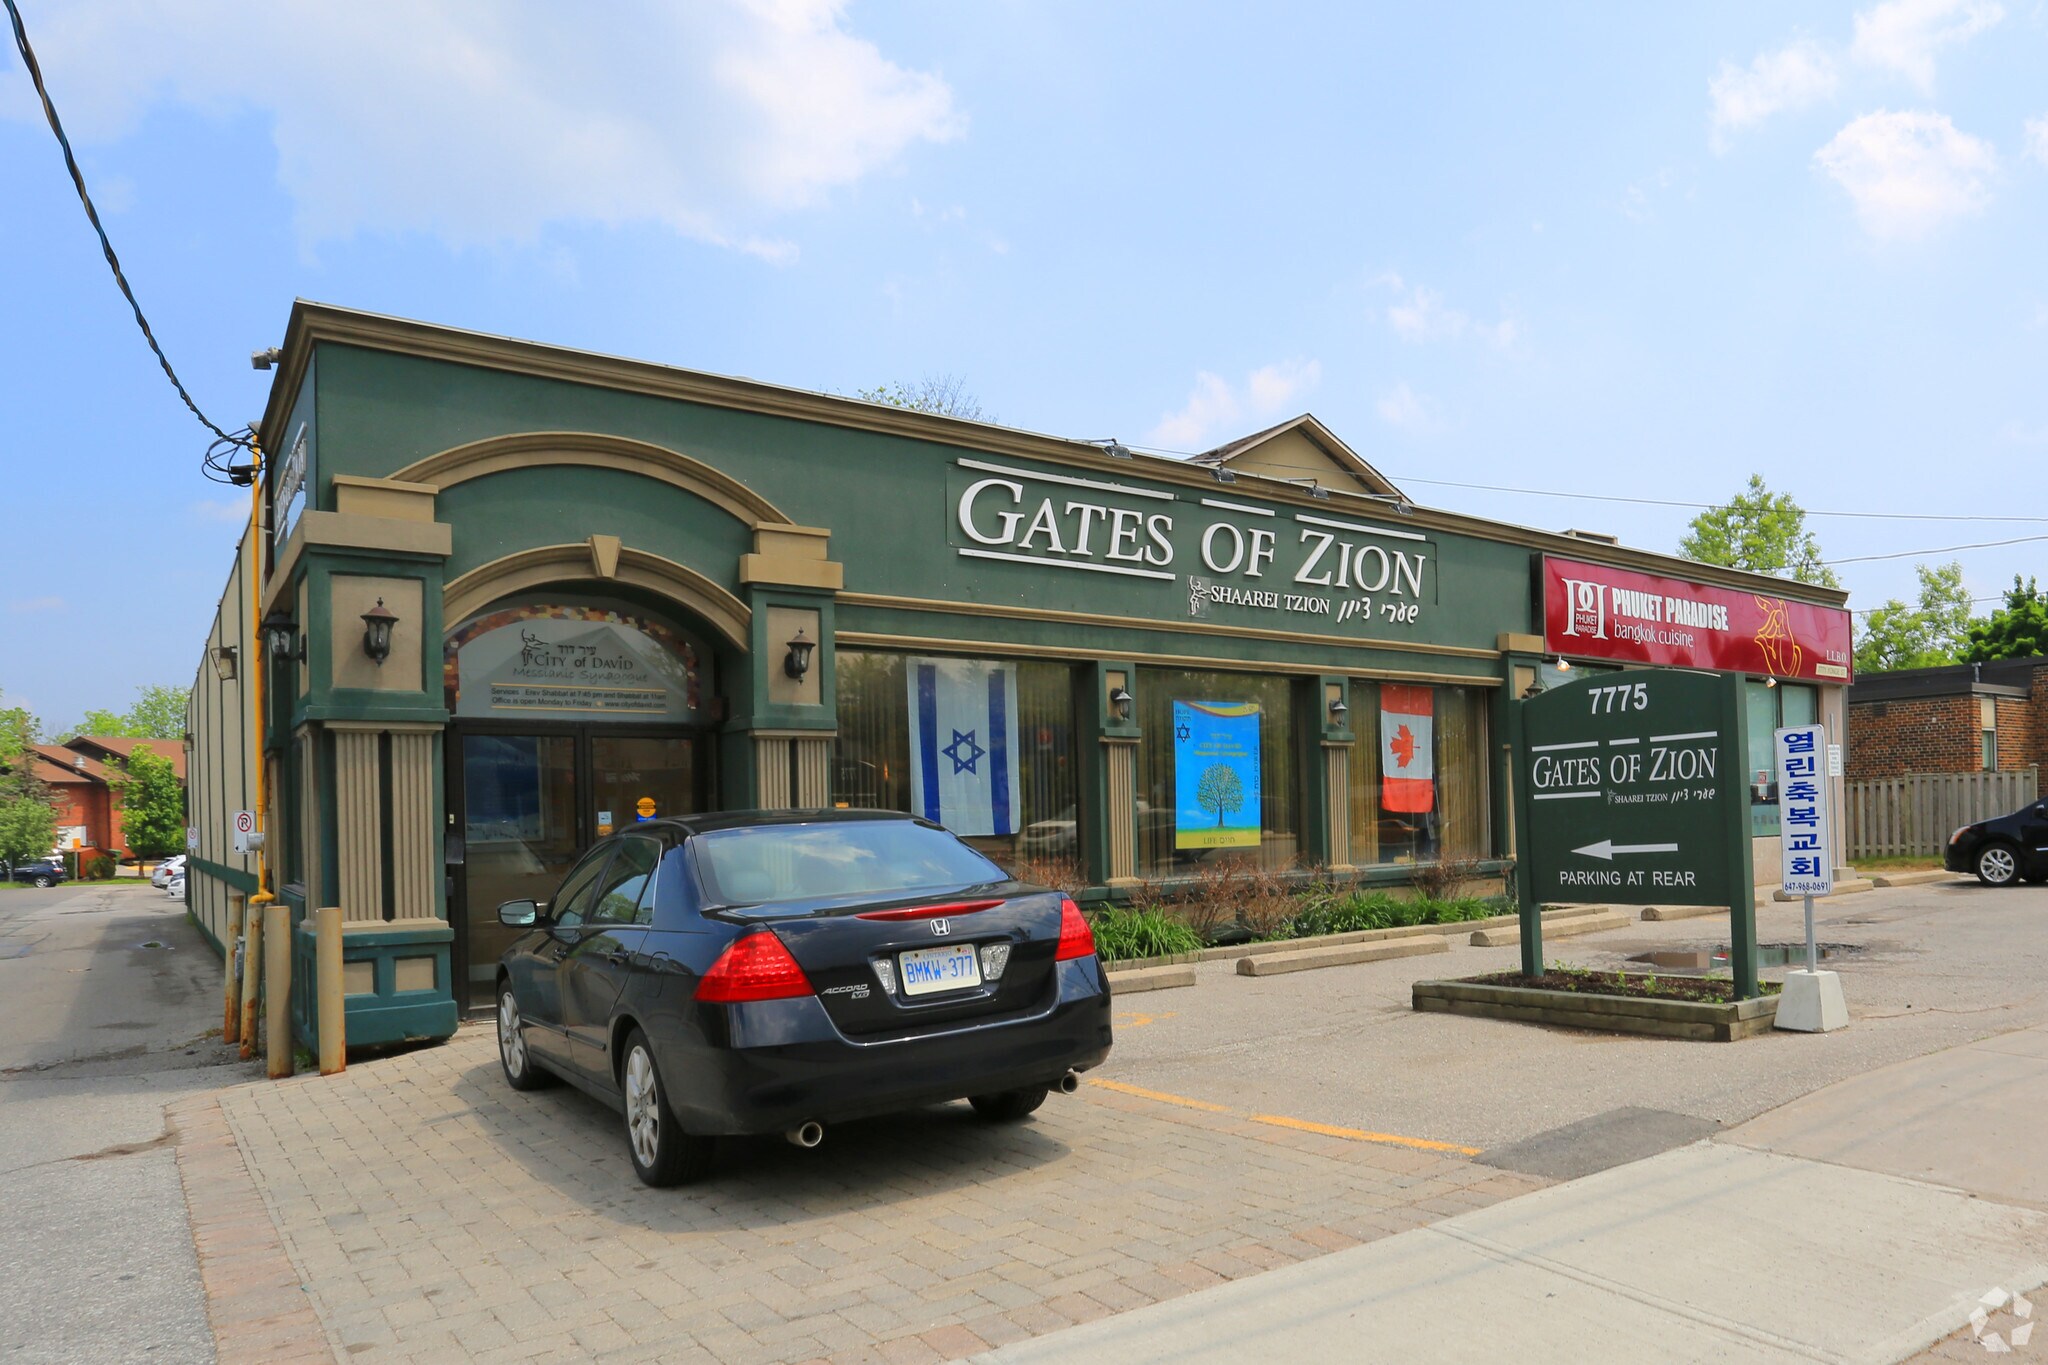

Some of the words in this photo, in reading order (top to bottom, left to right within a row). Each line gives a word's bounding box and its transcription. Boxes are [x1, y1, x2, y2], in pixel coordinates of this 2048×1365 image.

[958, 478, 1174, 566] GATES
[1201, 522, 1276, 577] OF
[1294, 528, 1426, 598] ZION
[1210, 585, 1279, 609] SHAAREI
[1284, 594, 1331, 615] TZION
[1336, 596, 1371, 624] ציון
[1380, 601, 1419, 624] שערי
[1611, 587, 1663, 622] PHUKET
[1665, 598, 1729, 631] PARADISE
[1575, 613, 1597, 625] PHUKET
[1575, 624, 1597, 634] PARADISE
[1614, 618, 1656, 645] bangkok
[1658, 629, 1694, 648] cuisine
[574, 656, 587, 668] of
[513, 667, 575, 679] Messianic
[580, 670, 648, 684] Synagogue
[520, 699, 536, 707] open
[538, 699, 563, 707] Monday
[573, 700, 592, 708] Friday
[1588, 682, 1648, 714] 7775
[1532, 756, 1601, 789] GATES
[1610, 754, 1641, 784] OF
[1649, 747, 1718, 782] ZION
[1614, 793, 1644, 804] SHAAREI
[1645, 793, 1668, 802] TZION
[1671, 788, 1689, 804] ציון
[1693, 787, 1716, 801] שערי
[1783, 731, 1822, 877] 열린축복교회
[1559, 870, 1621, 886] PARKING
[1627, 870, 1645, 886] AT
[1653, 871, 1696, 886] REAR
[1784, 881, 1829, 891] 647-968-0691
[821, 983, 868, 995] ACCORD
